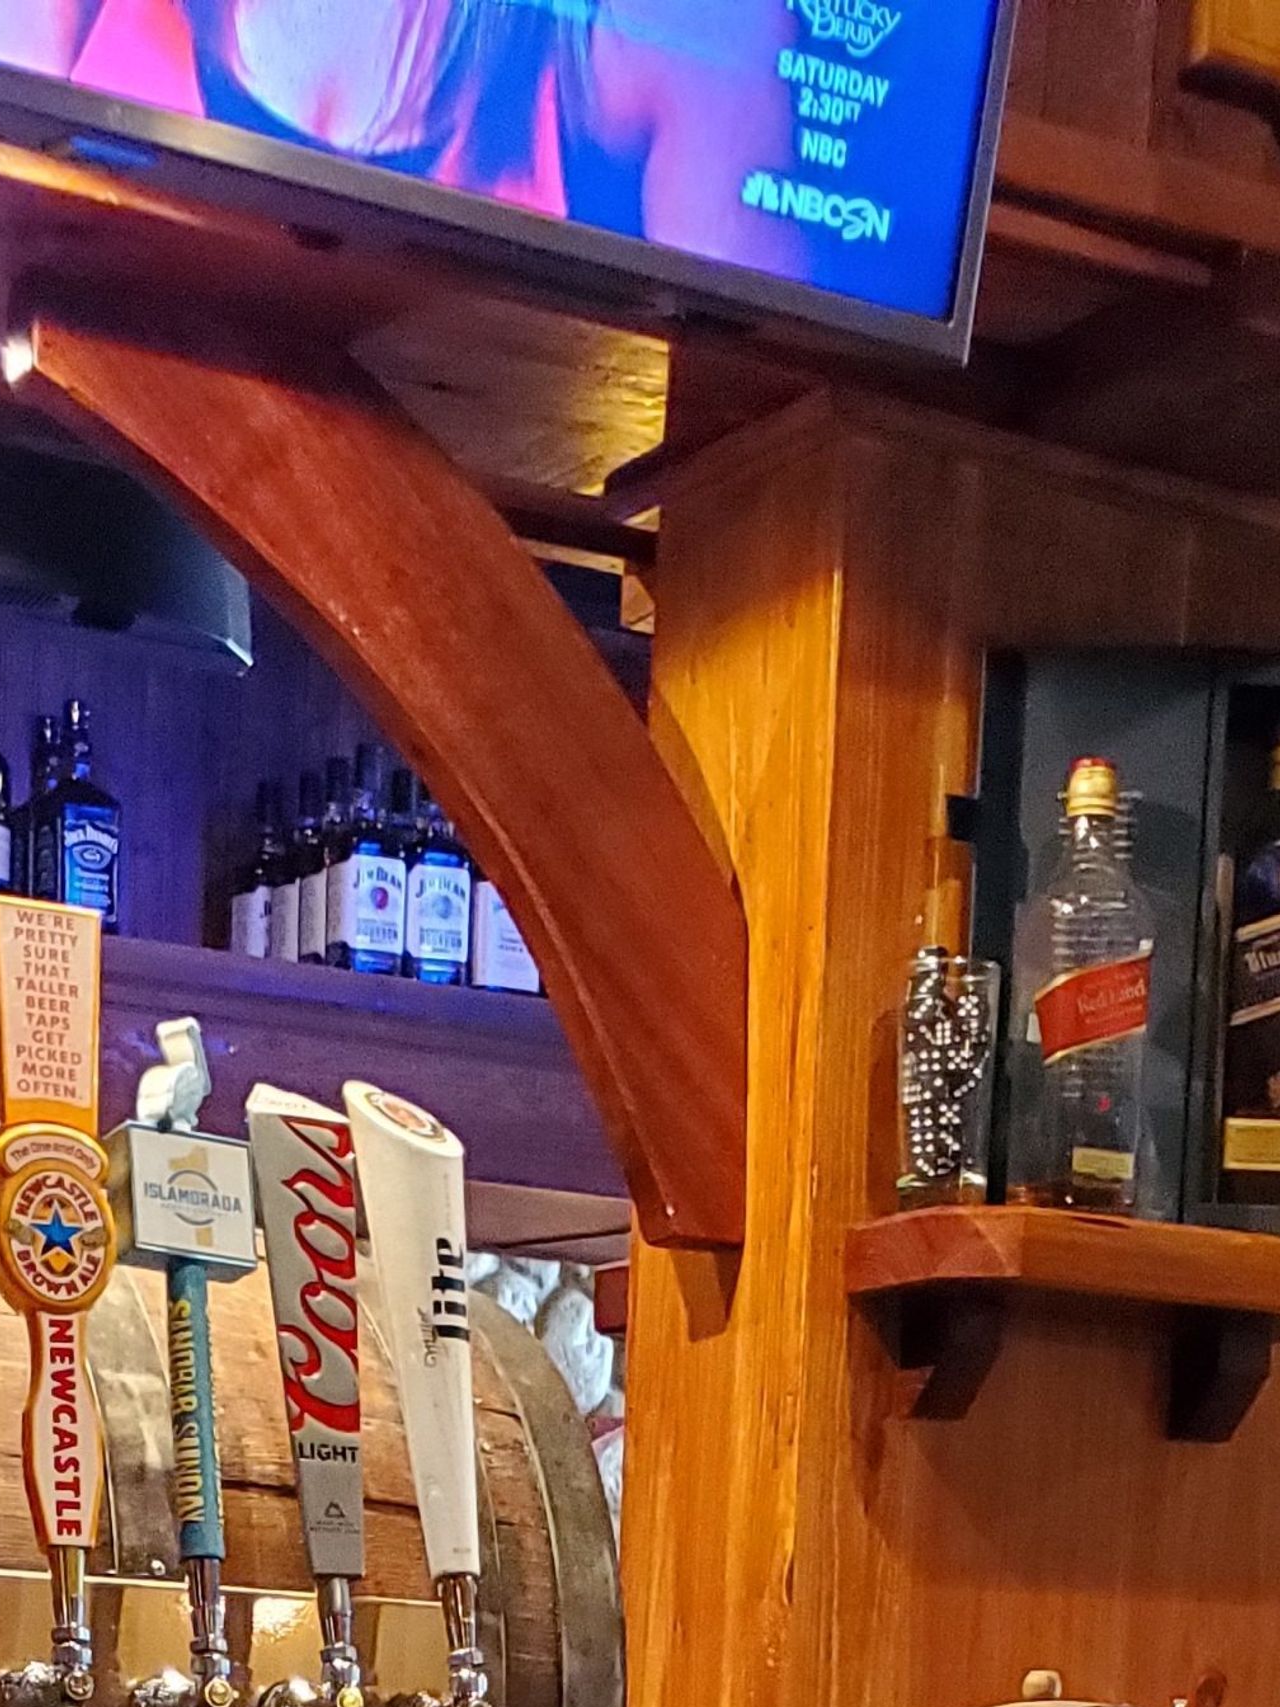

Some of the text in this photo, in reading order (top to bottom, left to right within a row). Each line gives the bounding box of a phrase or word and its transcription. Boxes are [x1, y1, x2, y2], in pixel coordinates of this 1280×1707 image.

[778, 49, 889, 109] SATURDAY
[801, 127, 847, 169] NBC
[779, 178, 890, 242] NBCSN
[16, 909, 75, 931] WE'RE
[14, 926, 79, 948] PRETTY
[23, 944, 70, 964] SURE
[24, 961, 70, 980] THAT
[15, 976, 80, 999] TALLER
[25, 995, 70, 1014] BEER
[25, 1012, 70, 1031] TAPS
[31, 1029, 67, 1047] GET
[15, 1044, 83, 1067] PICKED
[21, 1062, 78, 1083] MORE
[11, 1144, 29, 1162] The
[14, 1175, 99, 1224] NEWCASTLE
[143, 1181, 243, 1214] ISLAMORADA
[16, 1249, 102, 1297] BROWN ALE
[279, 1114, 361, 1435] Coors
[430, 1235, 471, 1343] lite
[47, 1318, 83, 1538] NEWCASTLE
[297, 1442, 360, 1464] LIGHT
